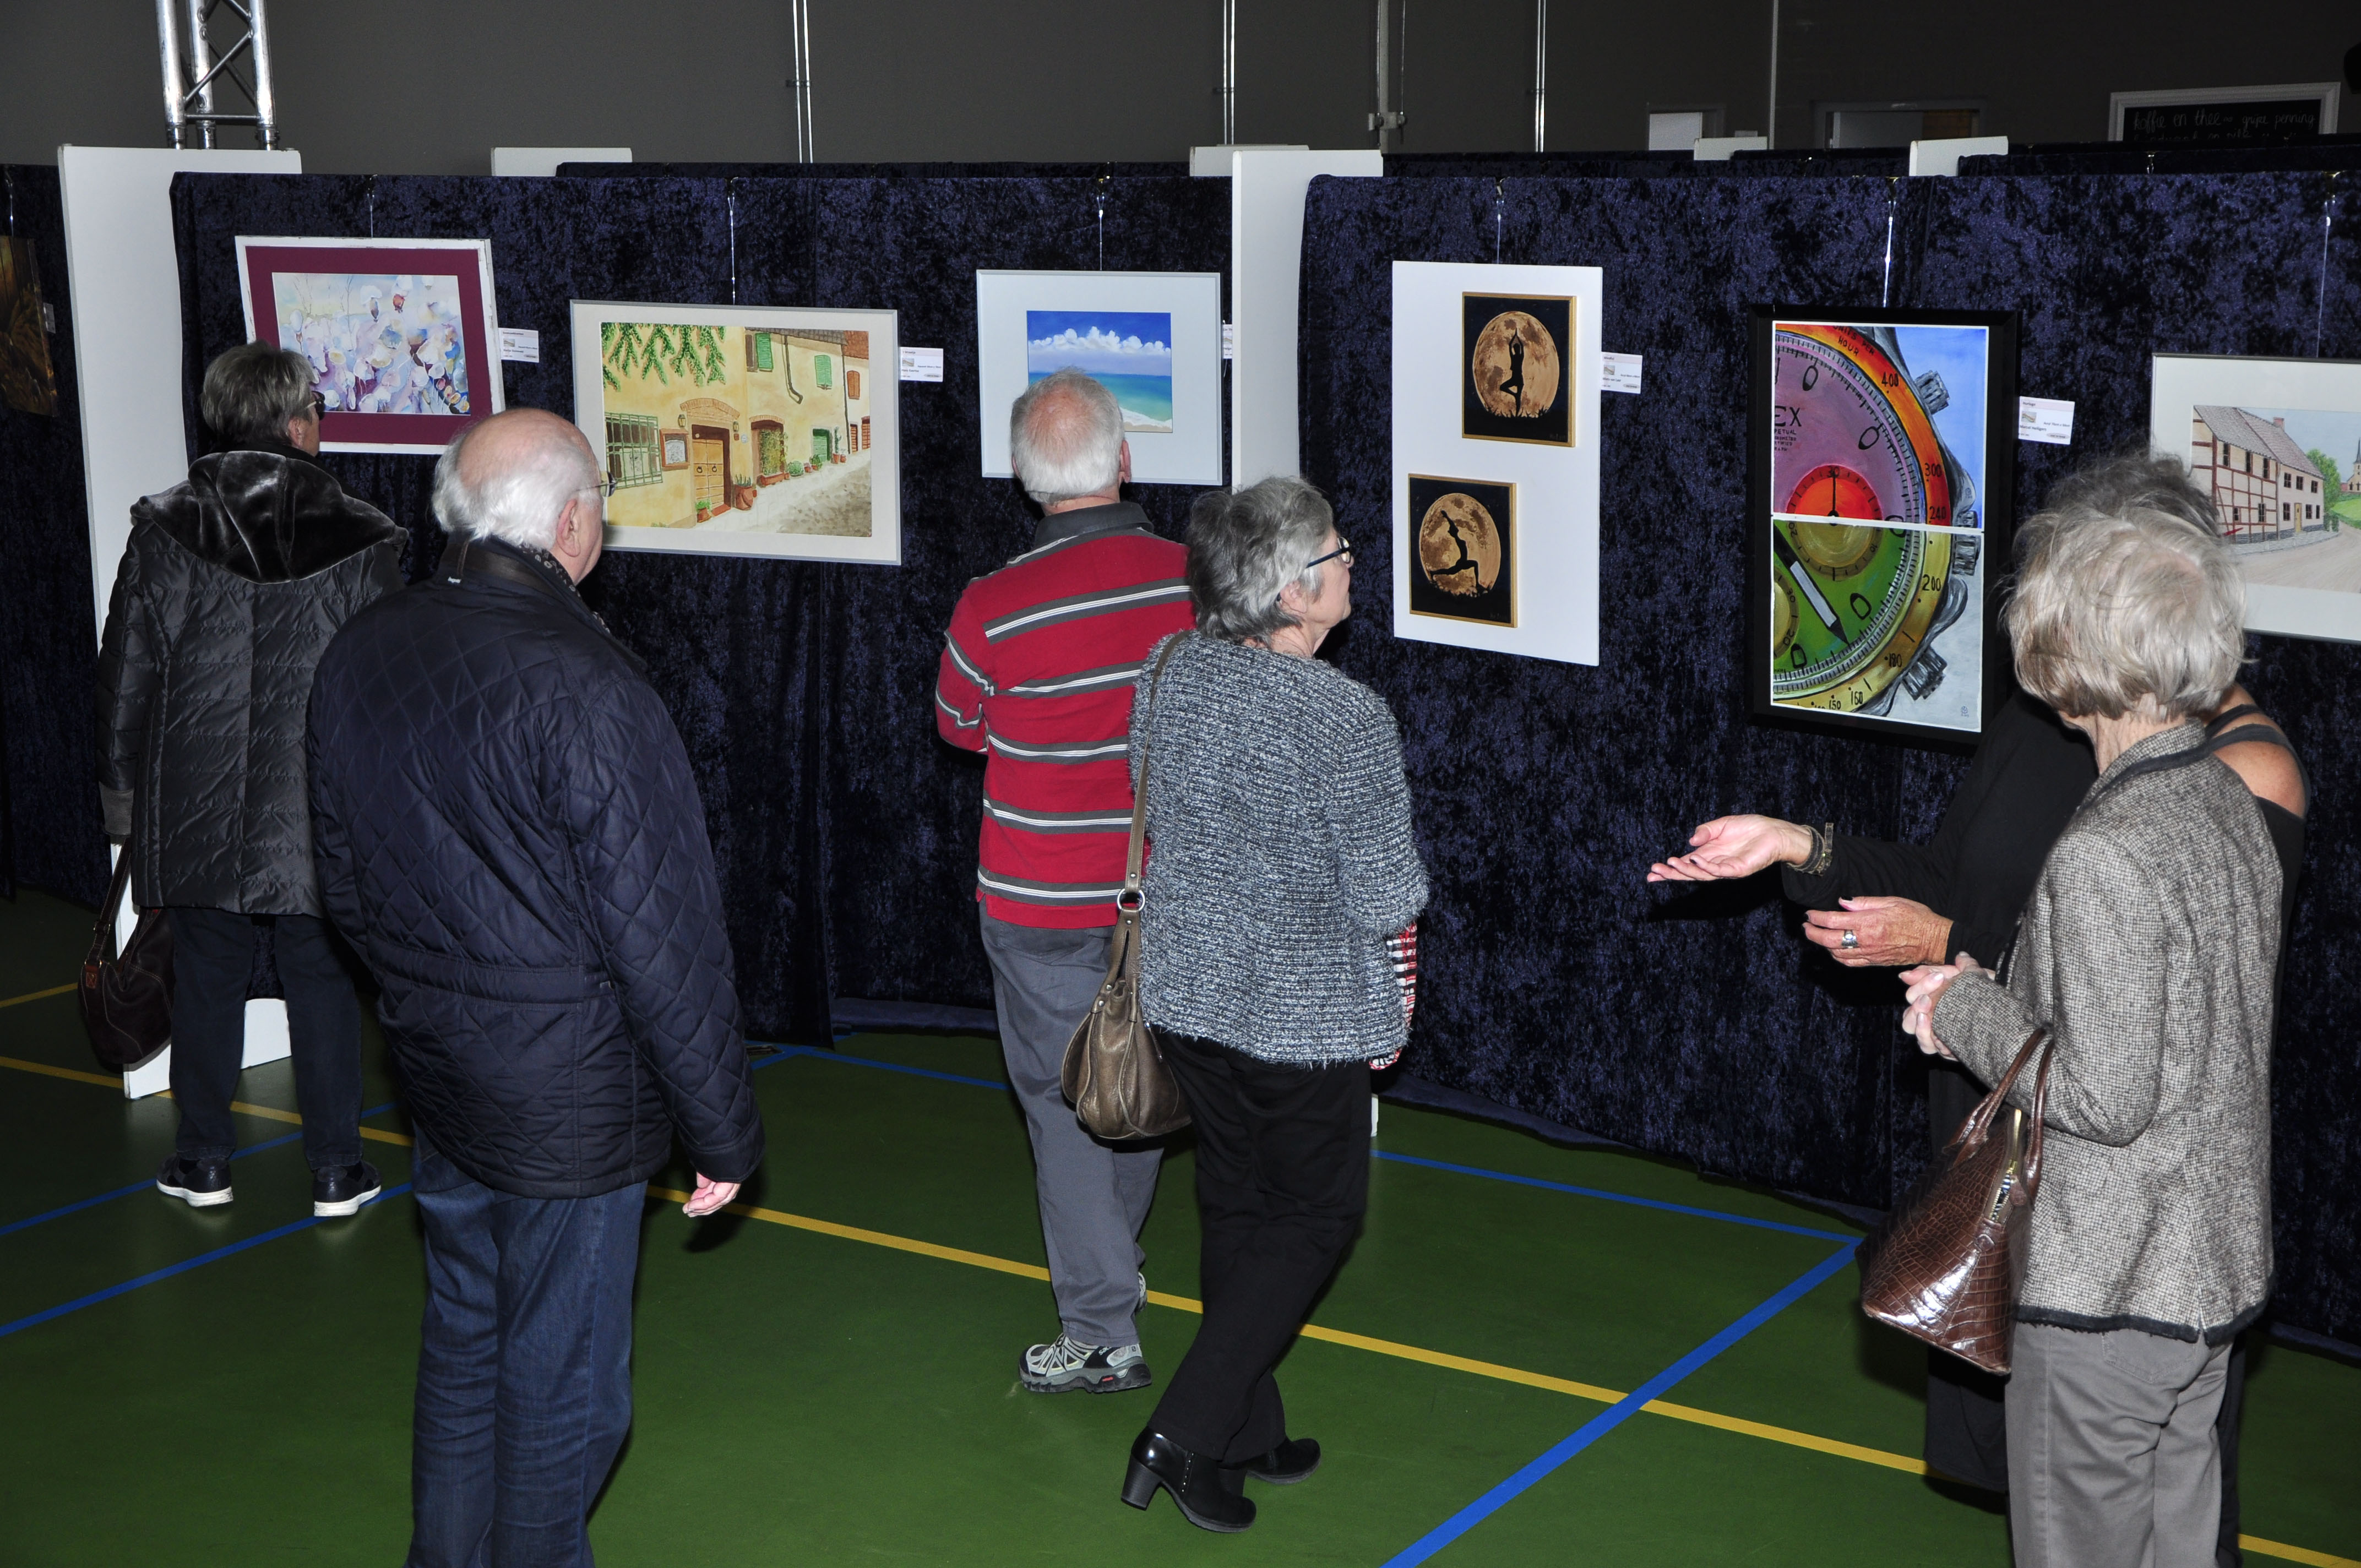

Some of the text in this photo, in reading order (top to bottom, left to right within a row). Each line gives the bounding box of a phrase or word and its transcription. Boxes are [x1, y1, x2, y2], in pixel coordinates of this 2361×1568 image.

[2132, 110, 2167, 134] koffie
[2173, 113, 2187, 127] en
[2194, 108, 2222, 127] thee
[1838, 335, 1859, 356] HOUR
[1881, 371, 1899, 388] 400
[1775, 405, 1802, 427] EX
[1924, 462, 1943, 477] 300
[1929, 506, 1947, 520] 240
[1922, 574, 1941, 592] 200
[1889, 652, 1903, 668] 180
[1829, 699, 1841, 710] 150
[1850, 690, 1864, 705] 160
